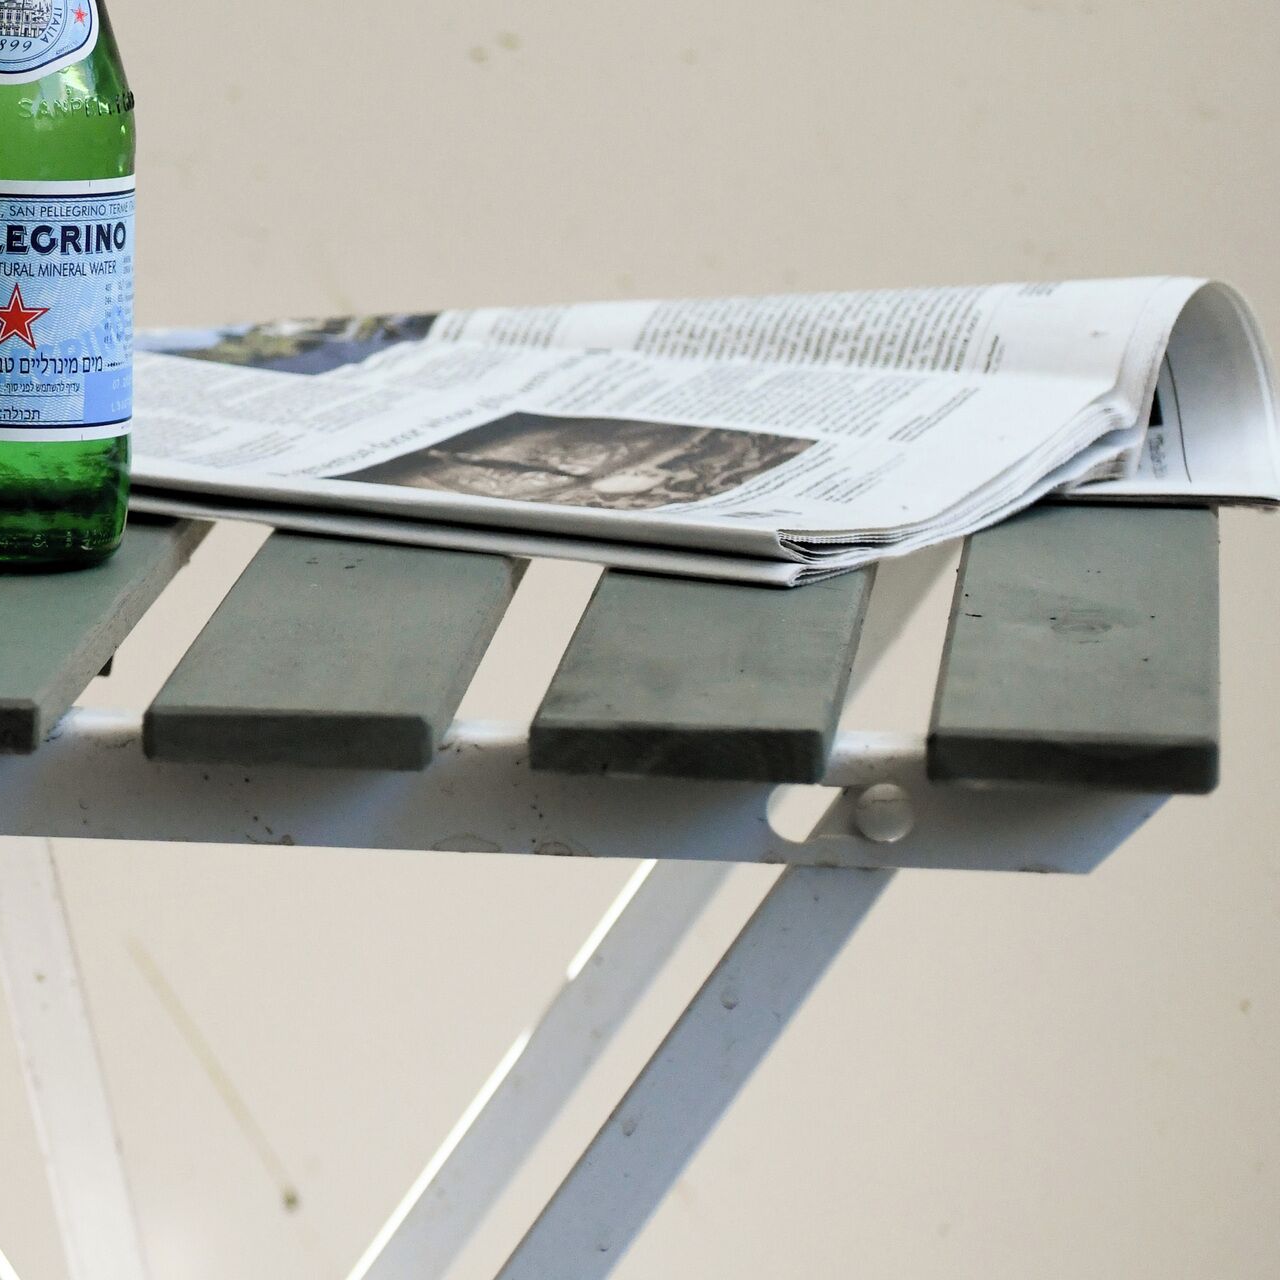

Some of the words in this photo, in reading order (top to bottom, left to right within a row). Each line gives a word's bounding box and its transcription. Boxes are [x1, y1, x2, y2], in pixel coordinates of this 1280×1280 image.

[40, 7, 63, 44] ITALIA
[9, 206, 35, 217] SAN
[40, 204, 107, 218] PELLEGRINO
[38, 262, 87, 278] MINERAL
[89, 260, 117, 275] WATER
[19, 352, 79, 374] מינרליים
[82, 356, 103, 373] מים
[0, 406, 41, 420] תכולה:
